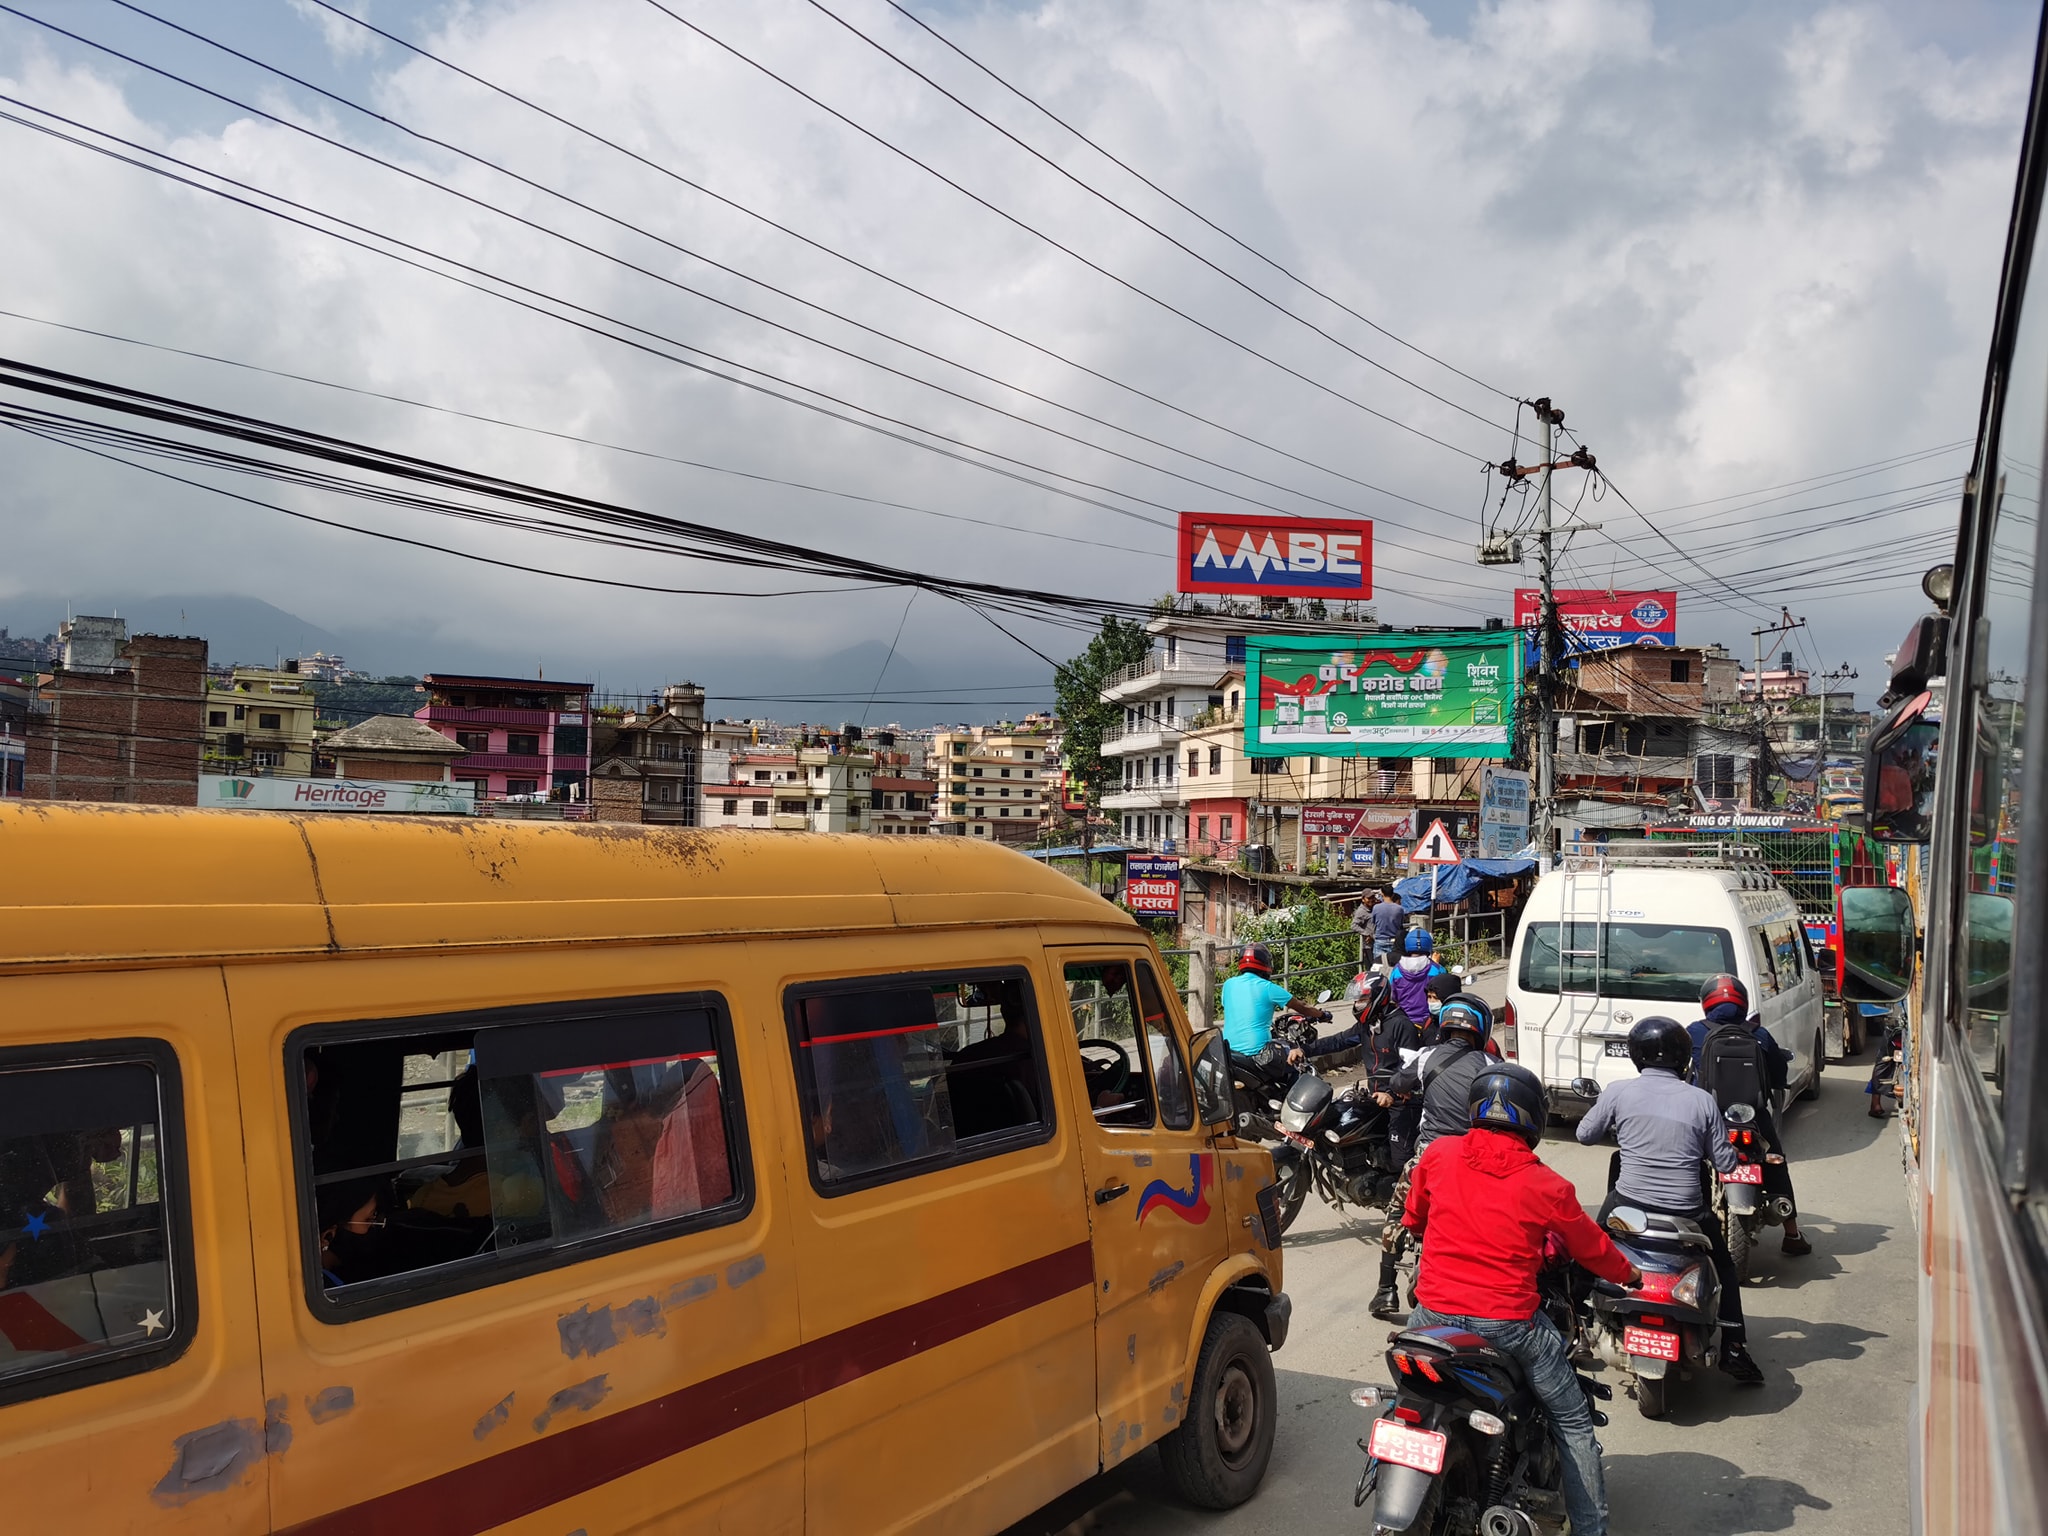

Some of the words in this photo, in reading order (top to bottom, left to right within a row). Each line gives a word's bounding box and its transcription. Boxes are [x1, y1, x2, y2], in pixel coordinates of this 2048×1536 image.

[1193, 528, 1362, 582] AMBE
[1467, 662, 1500, 680] शिवम्
[1362, 674, 1407, 691] करोड
[1409, 673, 1444, 691] बोरा
[294, 783, 387, 808] Heritage
[1689, 816, 1715, 826] KING
[1717, 816, 1731, 826] OF
[1732, 815, 1786, 827] NUWAKOT
[1129, 880, 1176, 896] औषधी
[1131, 897, 1174, 909] पसल
[1744, 894, 1783, 914] TOYOTA
